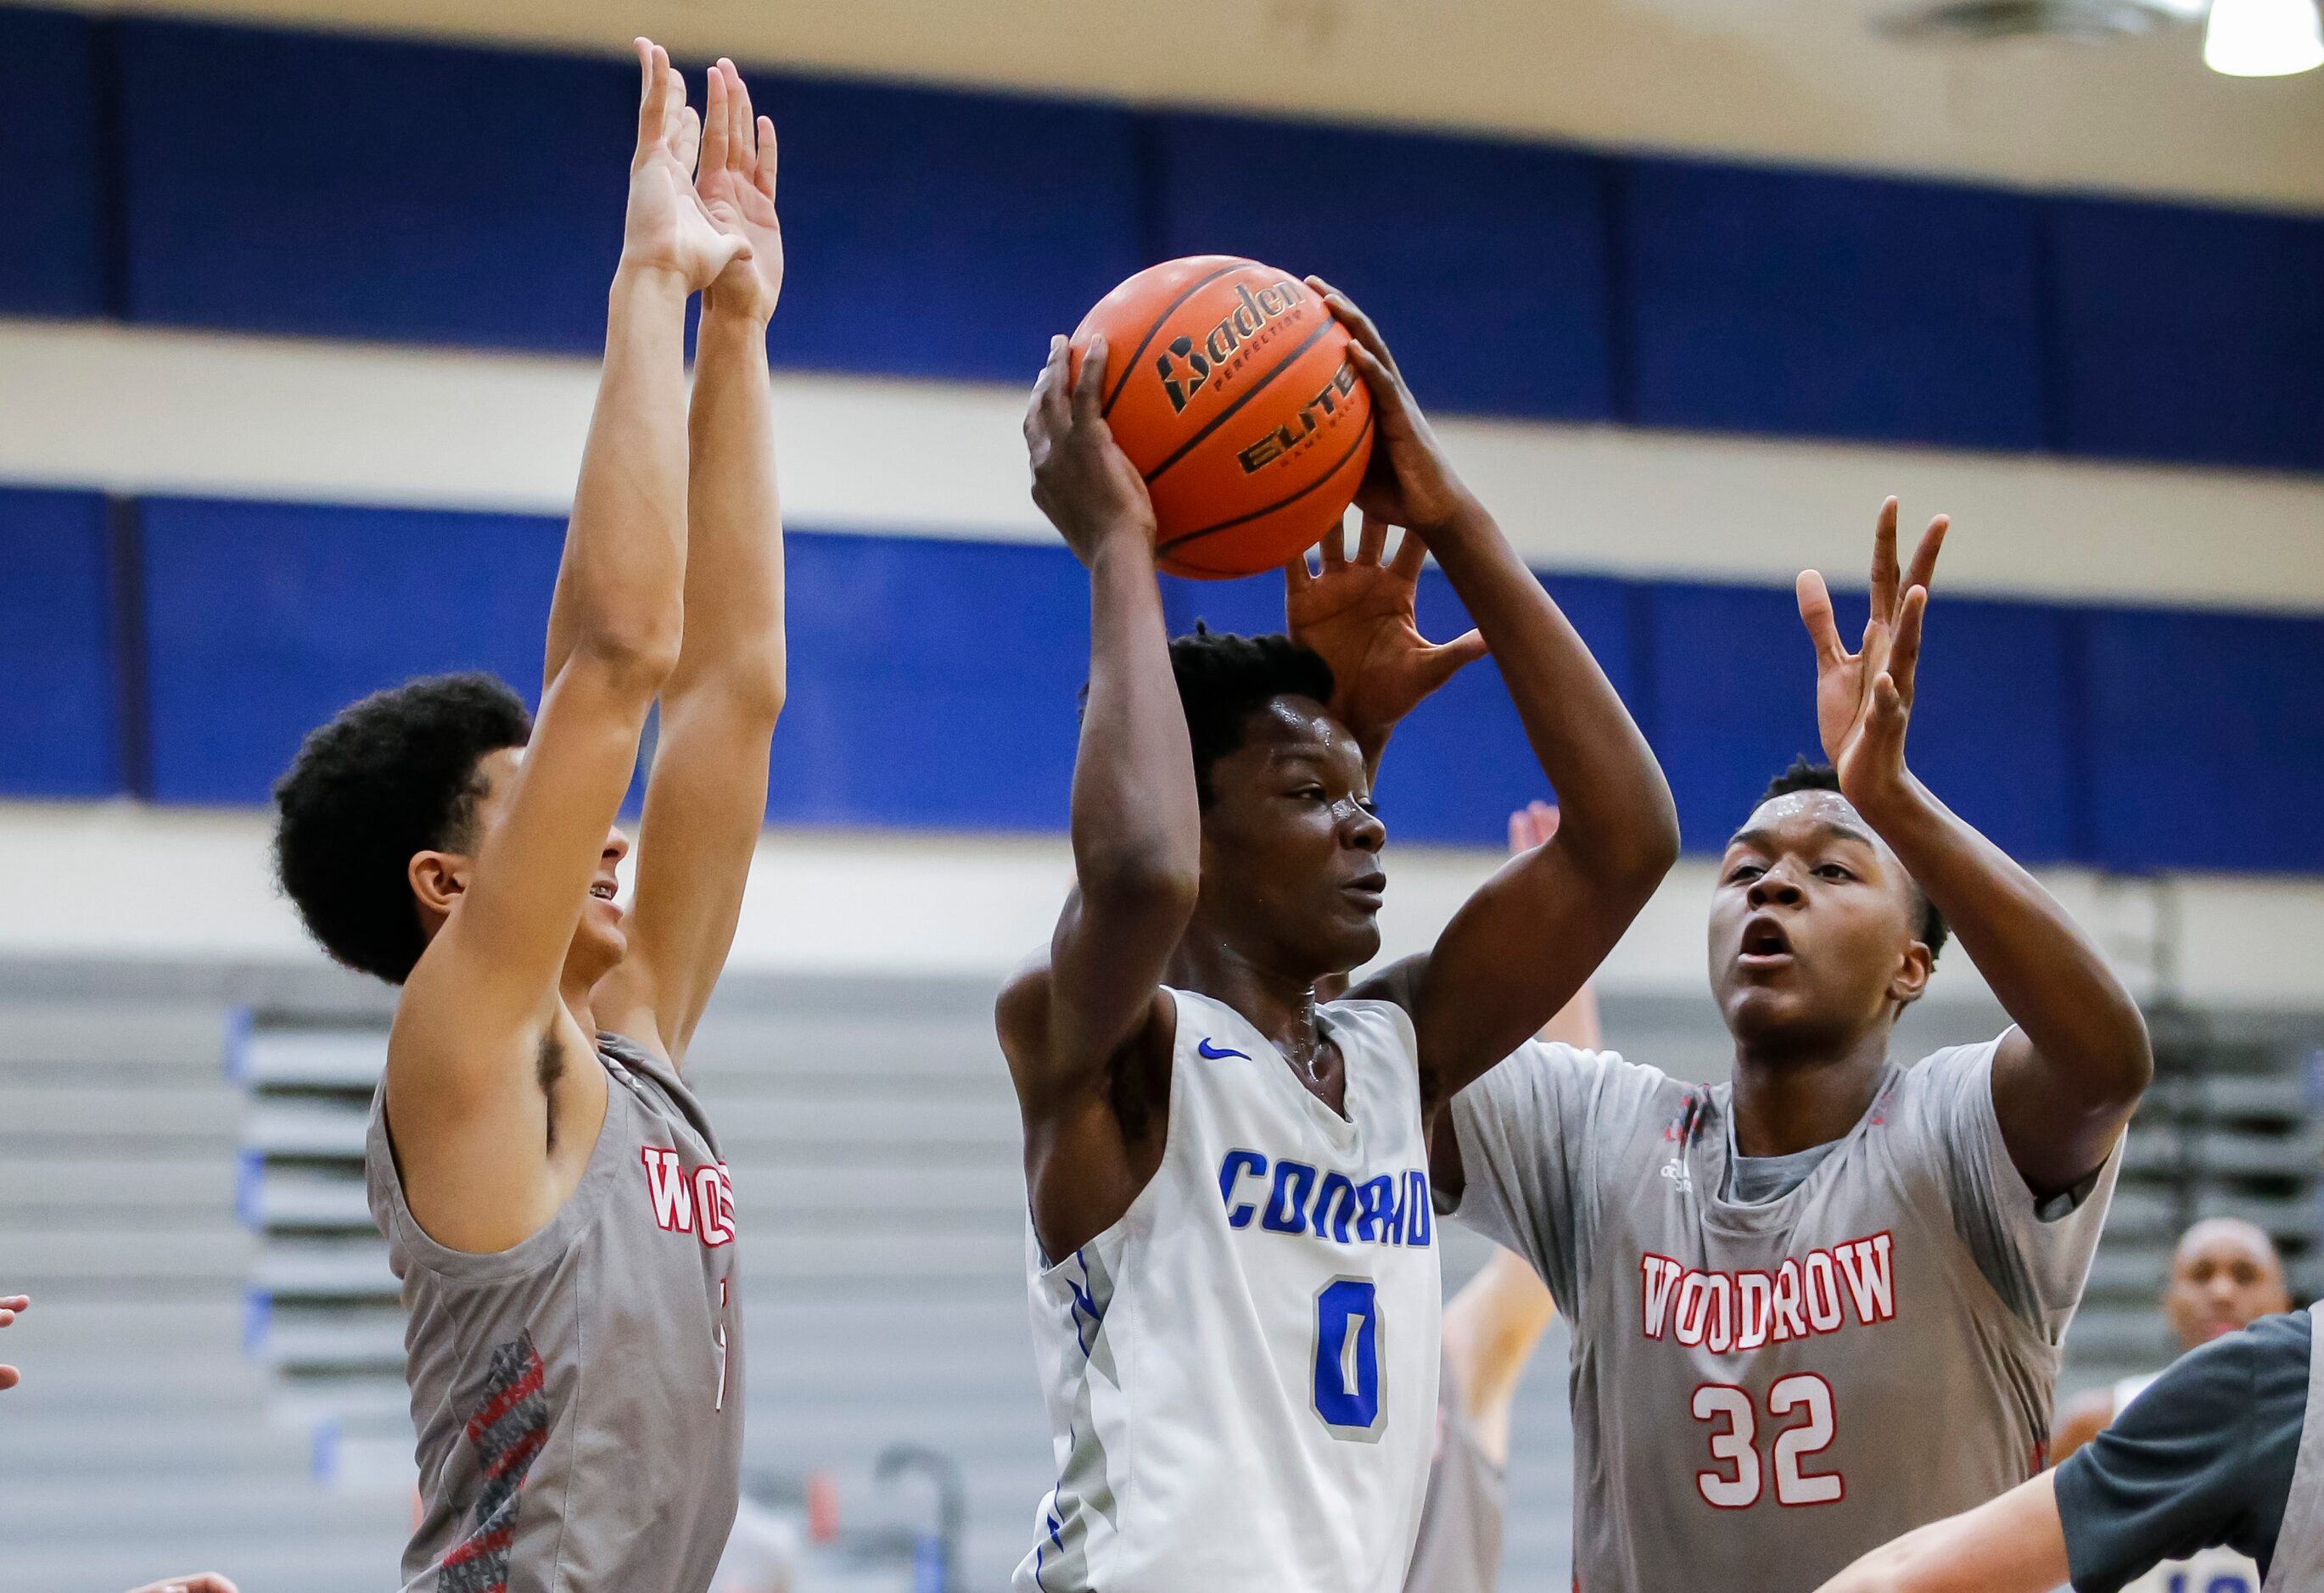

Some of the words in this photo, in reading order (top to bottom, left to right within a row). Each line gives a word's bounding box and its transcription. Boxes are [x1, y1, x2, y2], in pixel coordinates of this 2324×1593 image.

[1156, 281, 1306, 416] Baden
[1236, 360, 1358, 474] ELITE
[1309, 1273, 1390, 1445] 0
[1641, 1229, 1896, 1355] WOODROW
[1692, 1371, 1845, 1510] 32
